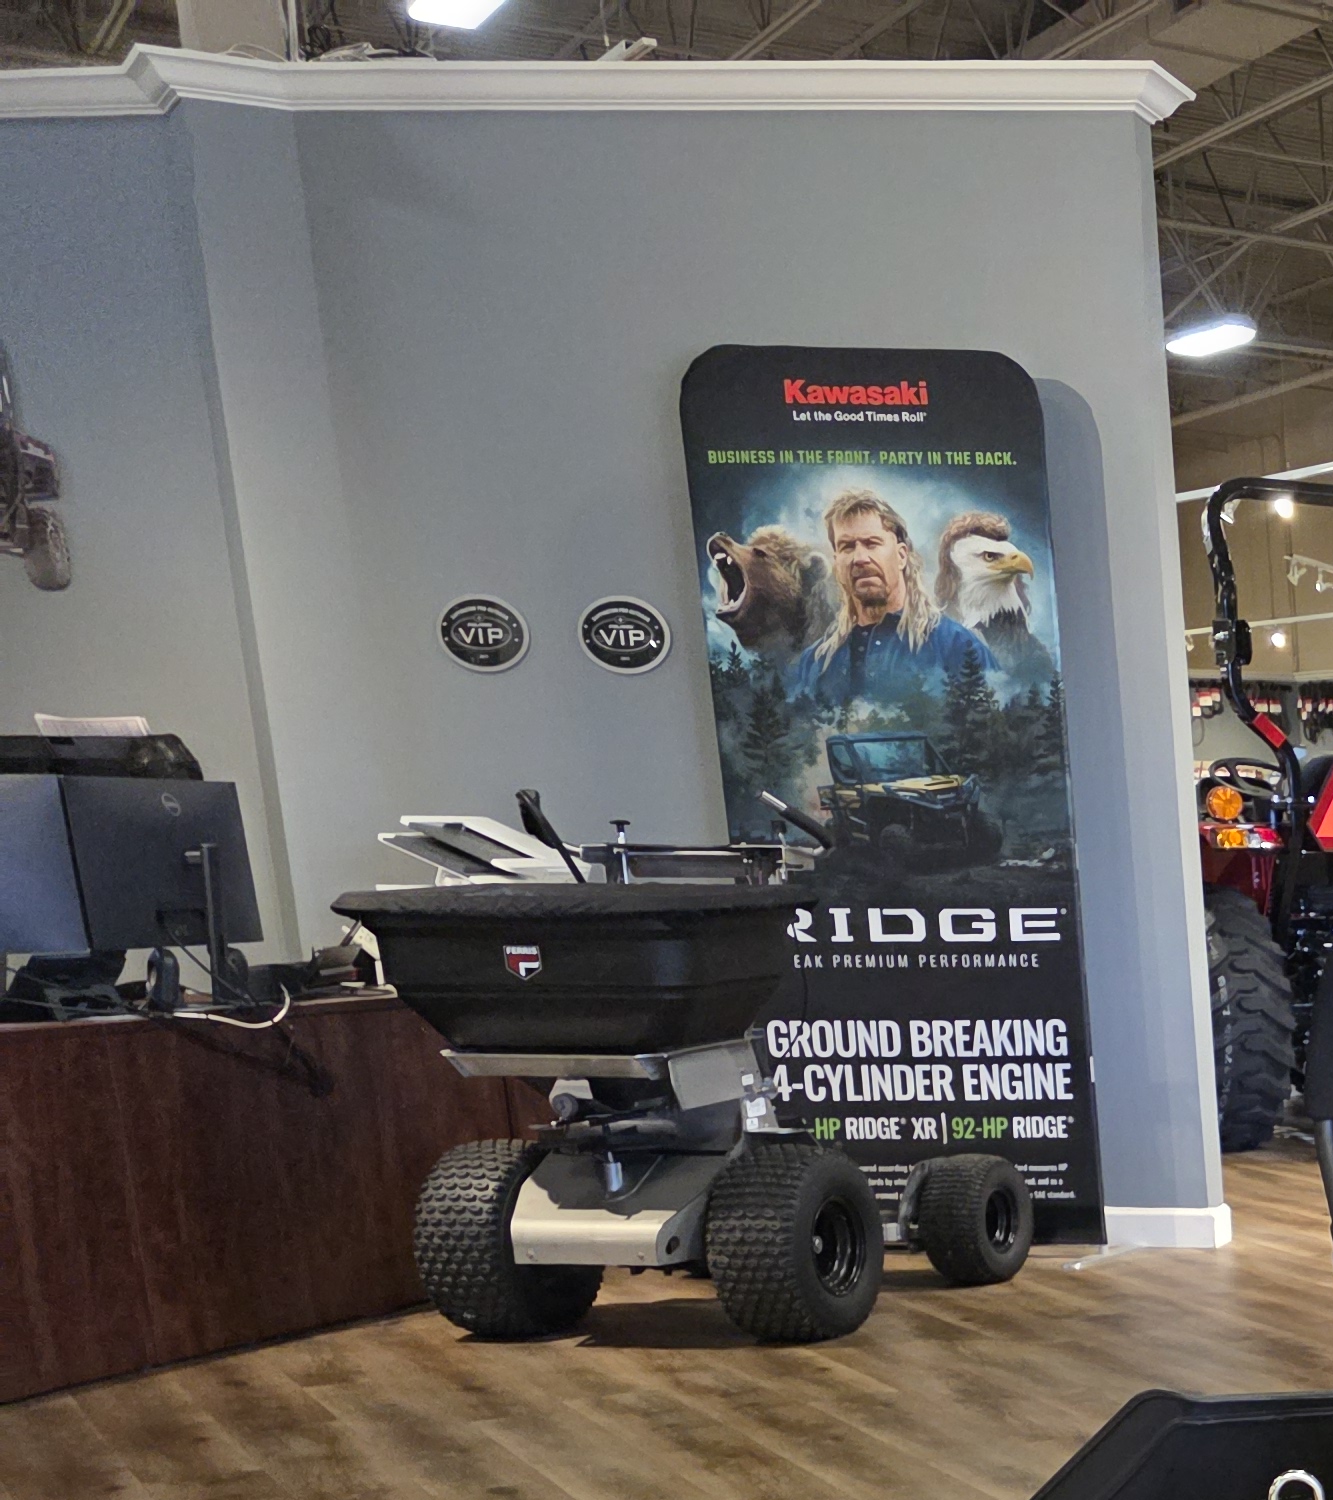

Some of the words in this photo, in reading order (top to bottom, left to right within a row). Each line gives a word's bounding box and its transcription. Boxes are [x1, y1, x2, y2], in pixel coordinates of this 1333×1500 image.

[783, 379, 929, 405] Kawasaki
[793, 410, 811, 421] Let
[814, 411, 832, 421] the
[834, 411, 864, 422] Good
[865, 411, 900, 422] Times
[708, 450, 775, 464] BUSINESS
[779, 450, 793, 464] IN
[796, 450, 823, 464] THE
[827, 450, 876, 464] FRONT.
[879, 451, 923, 465] PARTY
[927, 451, 942, 465] IN
[945, 451, 972, 465] THE
[975, 451, 1017, 466] BACK.
[458, 627, 503, 645] VIP
[598, 629, 645, 647] VIP
[786, 907, 1061, 943] RIDGE
[793, 954, 824, 969] EAK
[832, 954, 909, 969] PREMIUM
[918, 953, 1040, 968] PERFORMANCE
[766, 1019, 901, 1059] GROUND
[908, 1019, 1068, 1058] BREAKING
[773, 1064, 955, 1102] 4-CYLINDER
[962, 1062, 1074, 1102] ENGINE
[803, 1117, 841, 1140] -HP
[911, 1117, 938, 1140] XR
[951, 1116, 1009, 1139] 92-HP
